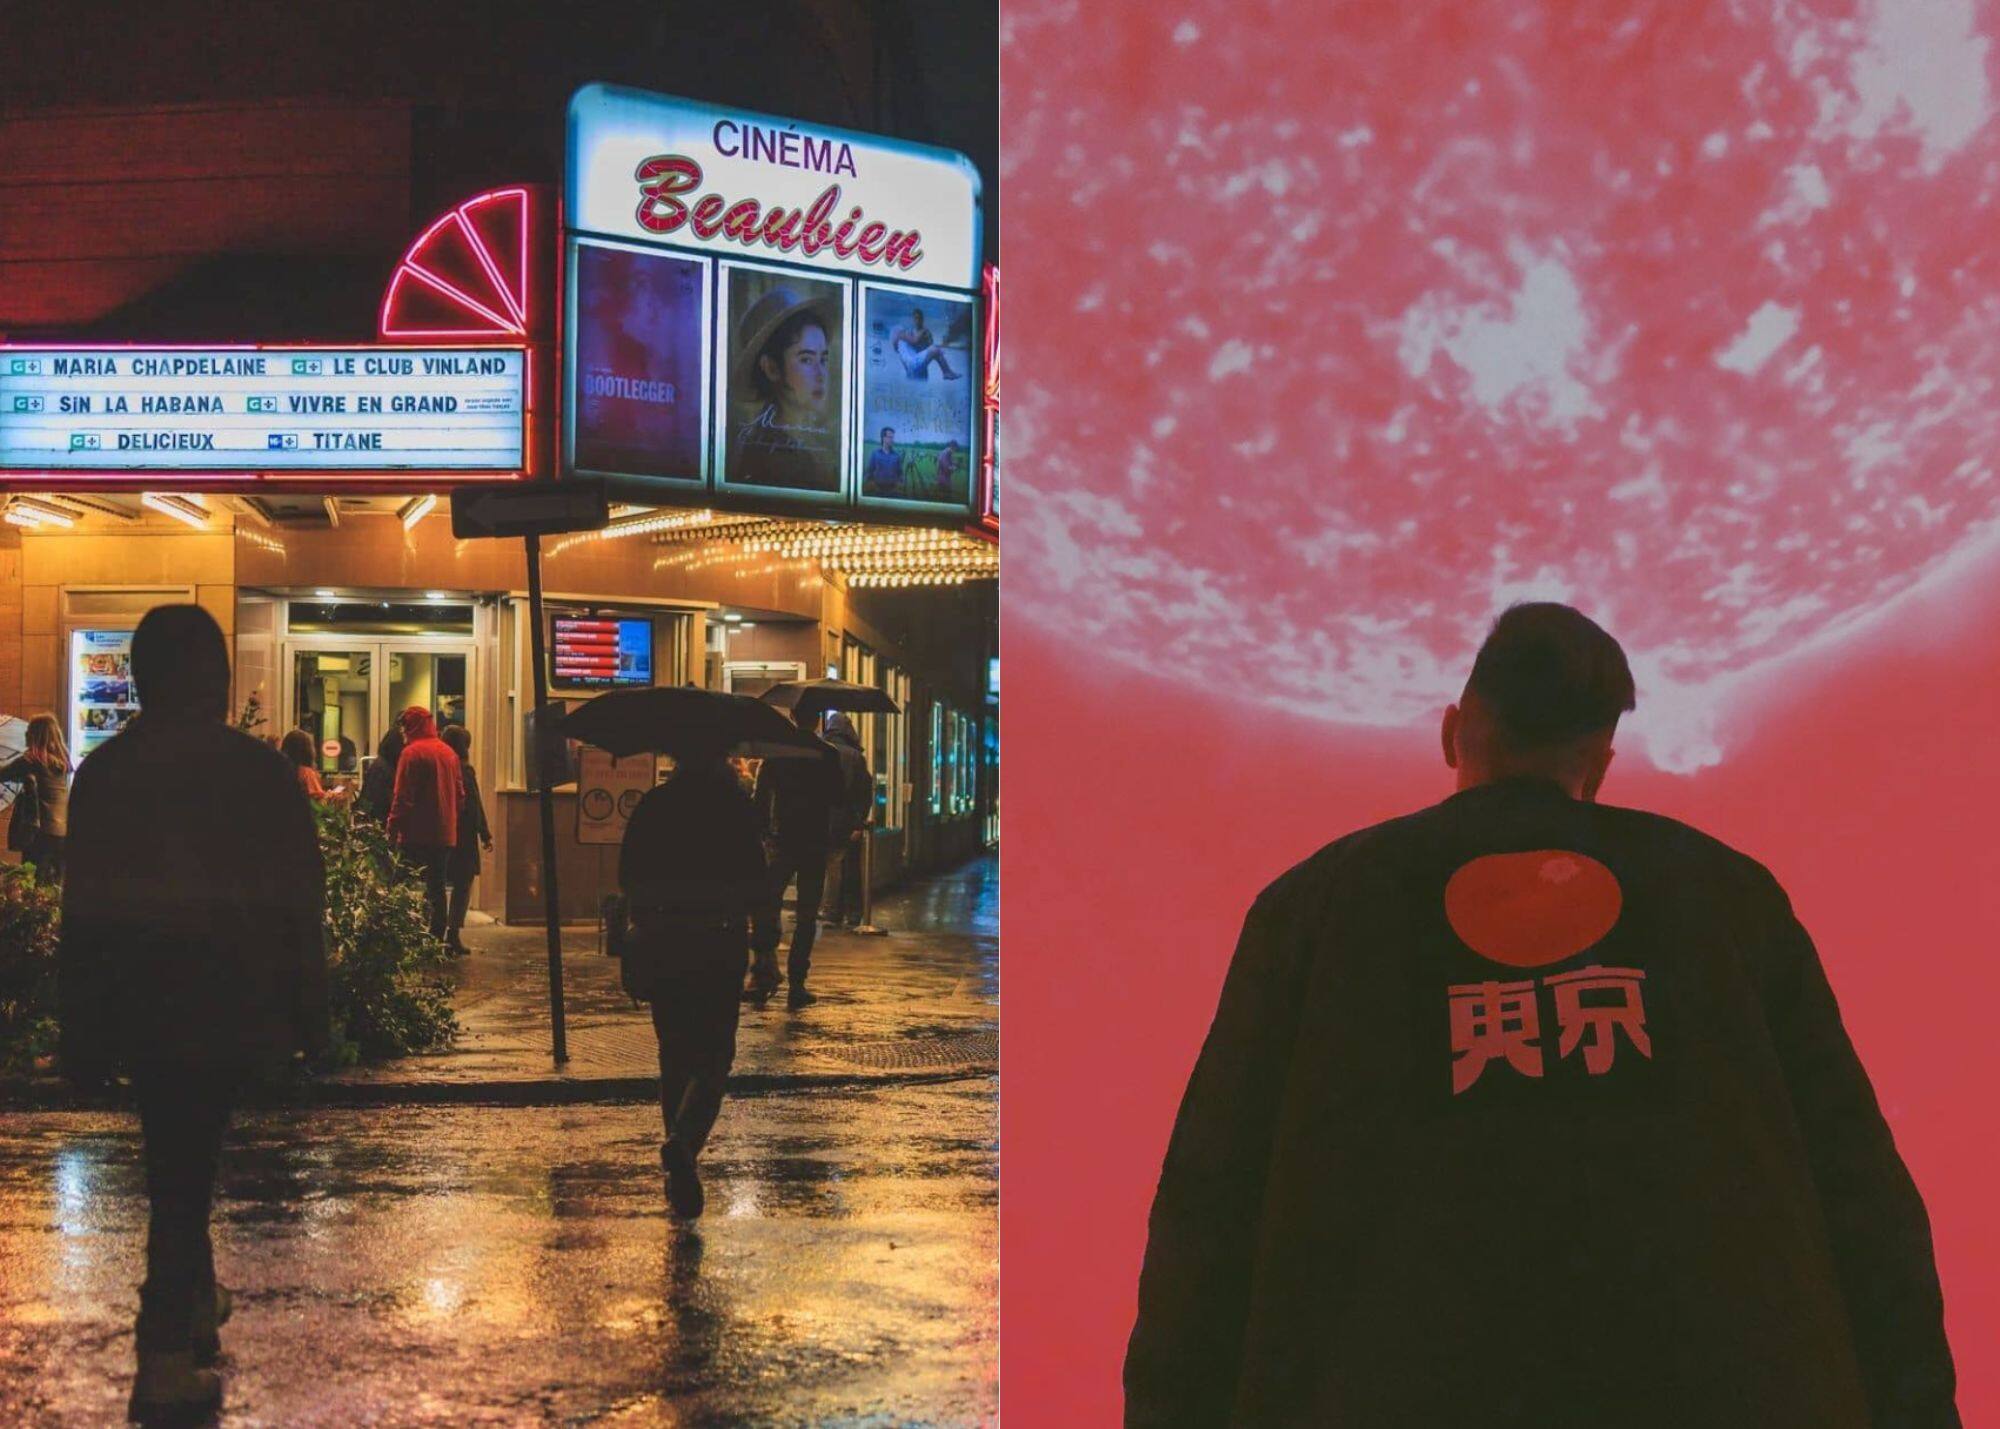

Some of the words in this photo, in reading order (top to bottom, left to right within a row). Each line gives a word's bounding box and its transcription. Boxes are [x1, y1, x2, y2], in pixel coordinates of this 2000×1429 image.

[713, 119, 857, 178] CINÉMA
[635, 155, 923, 270] Beaubien
[54, 357, 117, 375] MARIA
[133, 357, 266, 375] CHAPDELAINE
[334, 357, 355, 375] LE
[365, 357, 414, 375] CLUB
[423, 357, 506, 375] VINLAND
[585, 374, 675, 403] BOOTLEGGER
[105, 397, 129, 413] LA
[142, 396, 224, 413] HABANA
[289, 396, 346, 413] VIVRE
[358, 396, 382, 413] EN
[391, 396, 458, 413] GRAND
[118, 433, 215, 450] DELICIEUX
[313, 433, 382, 450] TITANE
[1448, 966, 1651, 1095] 東京
